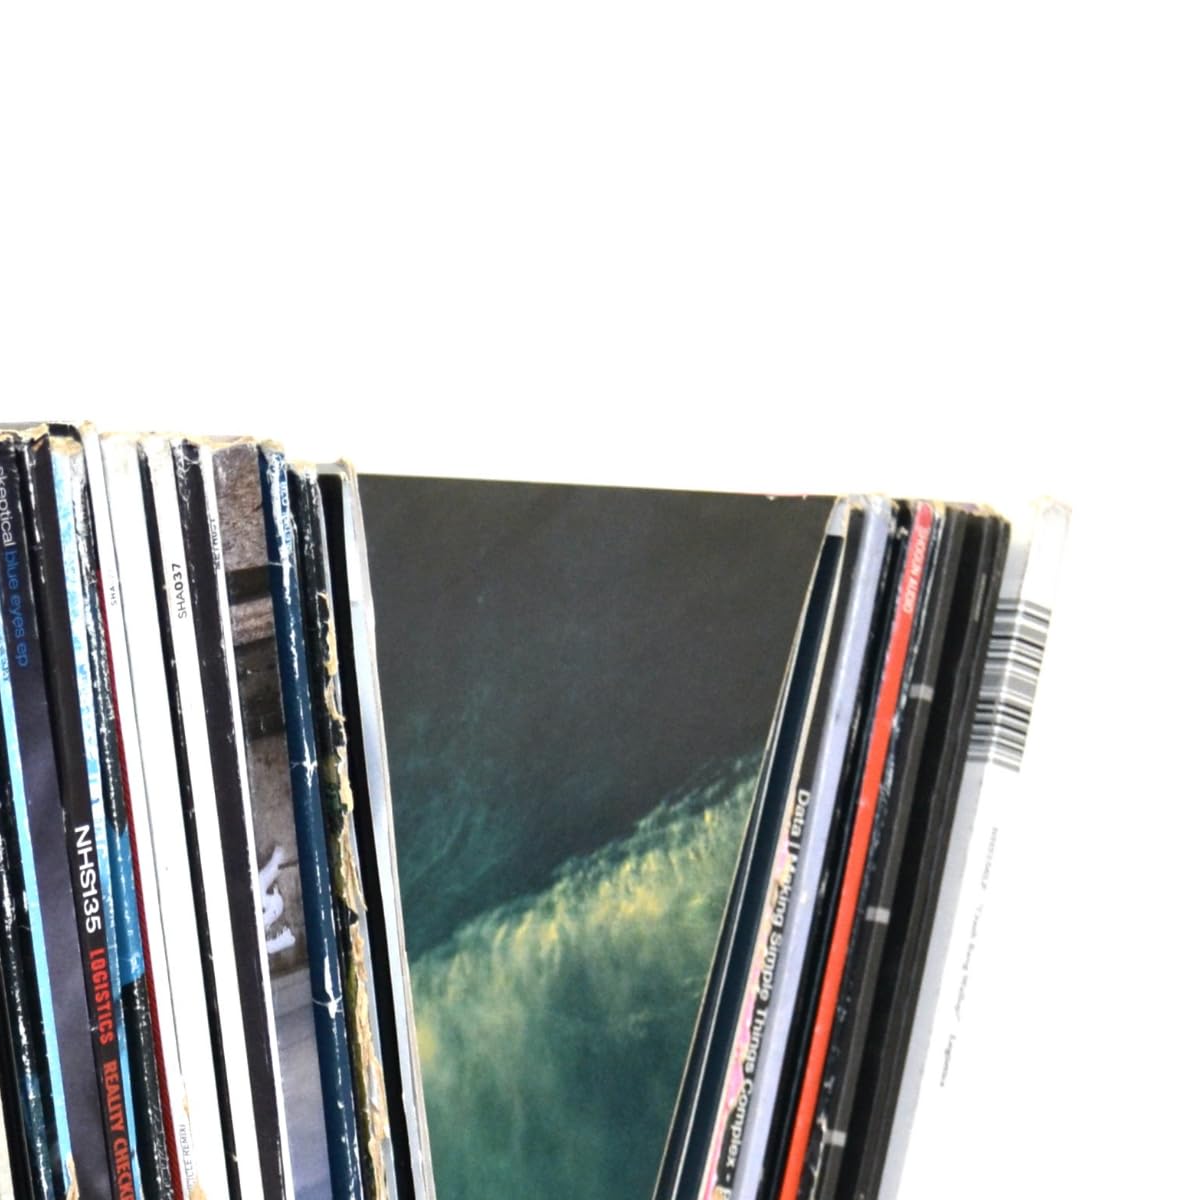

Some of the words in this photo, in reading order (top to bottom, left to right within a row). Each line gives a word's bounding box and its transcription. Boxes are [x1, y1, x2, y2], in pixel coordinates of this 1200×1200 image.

[4, 549, 20, 589] blue
[171, 563, 187, 619] SHA037
[9, 595, 26, 638] eyes
[14, 643, 29, 668] ep
[791, 789, 810, 837] Data
[771, 852, 799, 926] Making
[74, 824, 101, 934] NHS135
[89, 948, 115, 1045] LOGISTICS
[103, 1060, 125, 1134] REALITY
[757, 931, 784, 1001] Simple
[745, 1006, 769, 1071] Things
[726, 1079, 753, 1167] Complex
